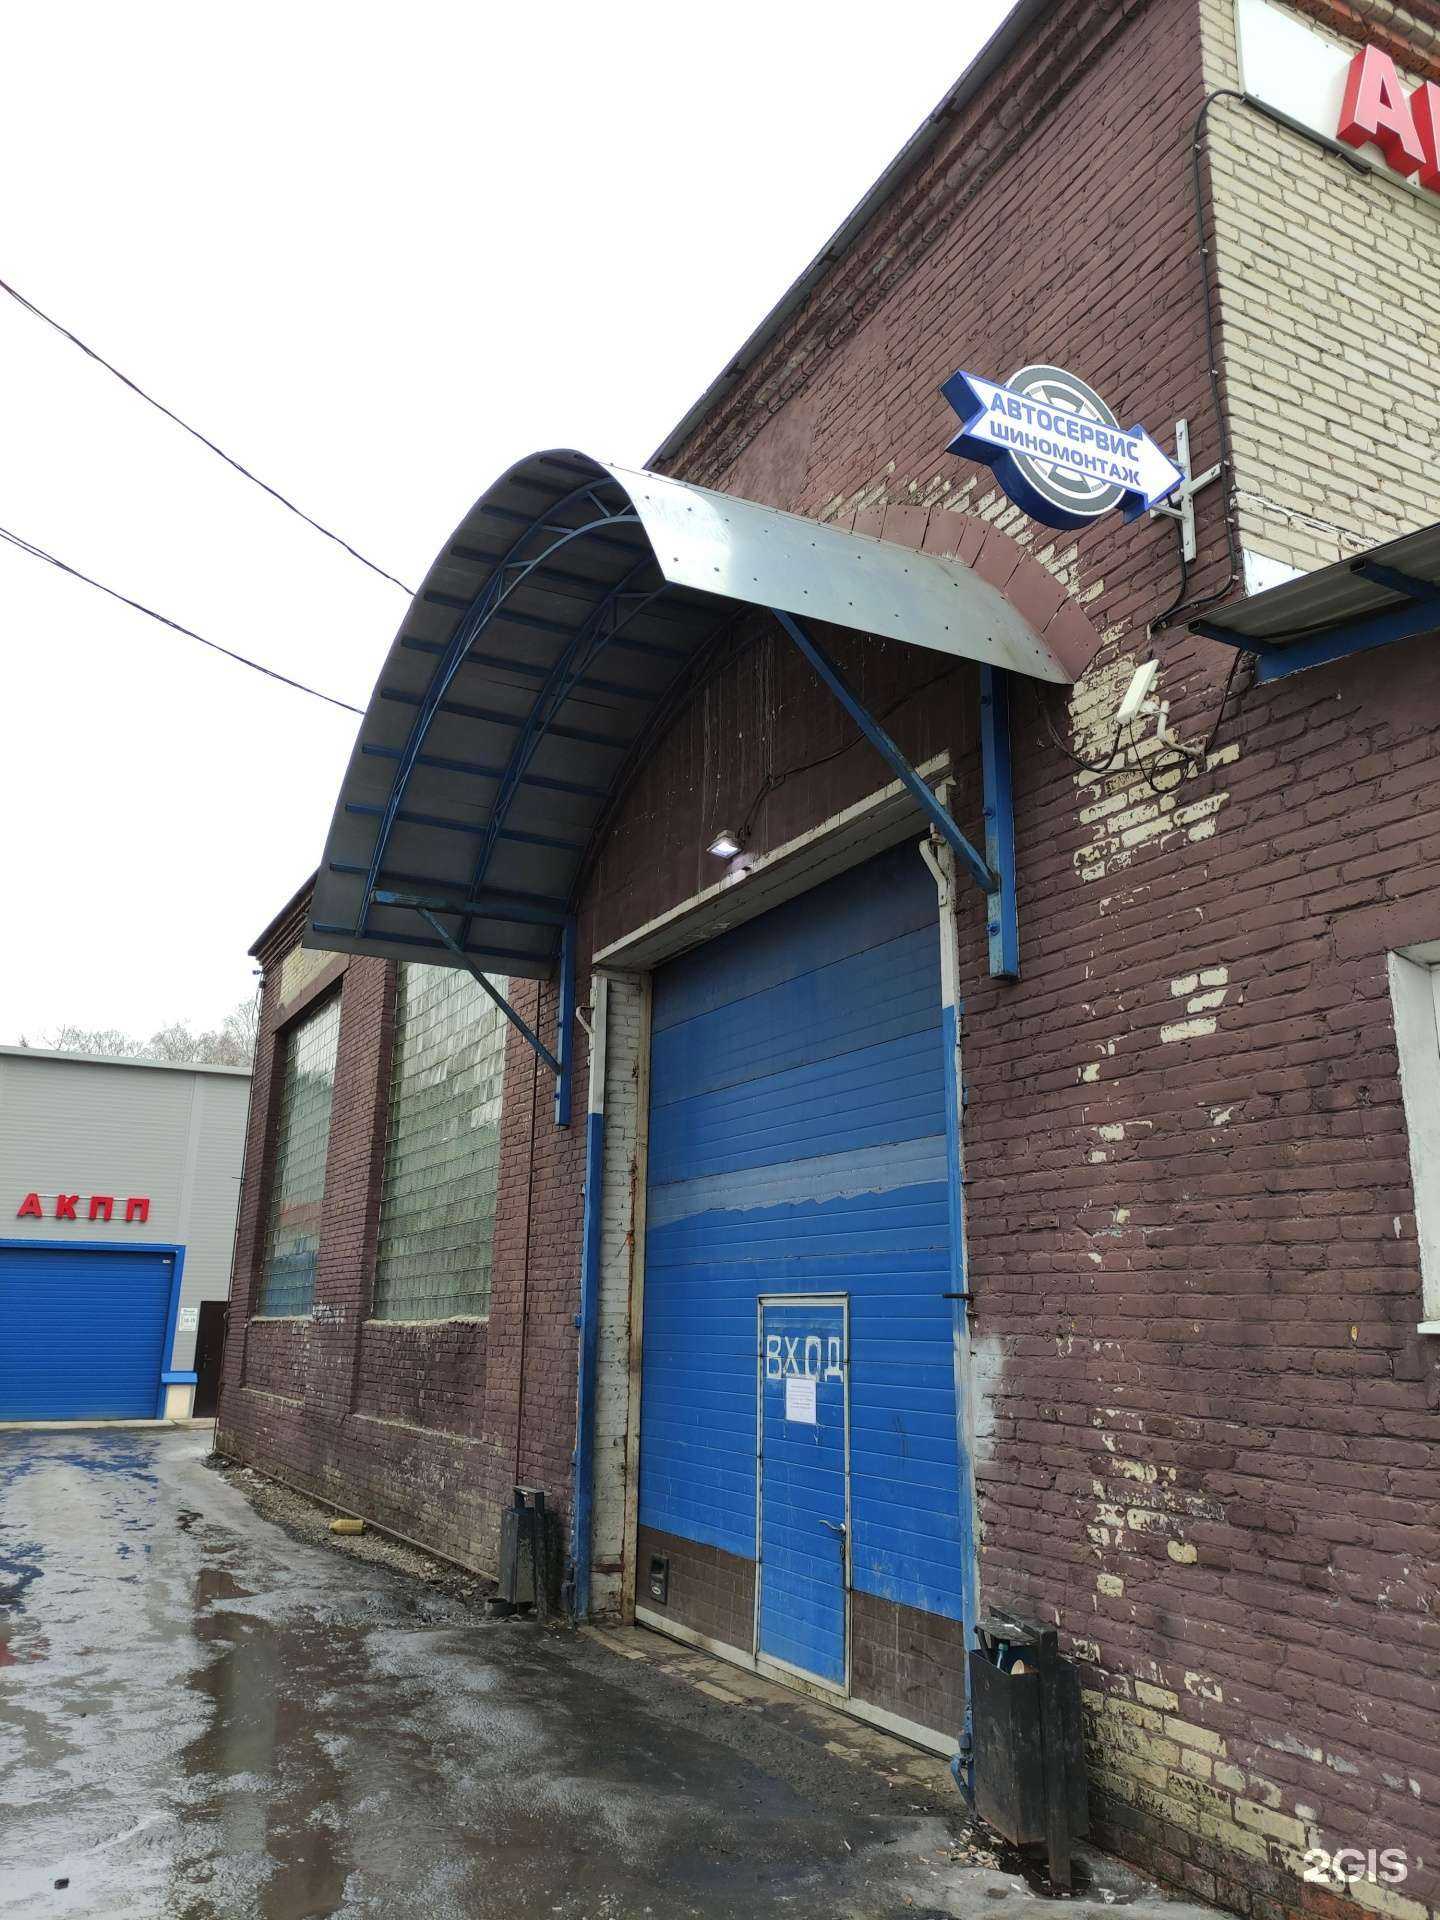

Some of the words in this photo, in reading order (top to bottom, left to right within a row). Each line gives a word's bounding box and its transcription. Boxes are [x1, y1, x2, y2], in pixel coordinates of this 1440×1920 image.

[1338, 43, 1440, 194] А
[989, 420, 1141, 486] ШИНОМОНТАЖ
[990, 392, 1139, 462] АВТОСЕРВИС
[16, 1192, 150, 1223] АКПП
[766, 1334, 844, 1382] ВХОД
